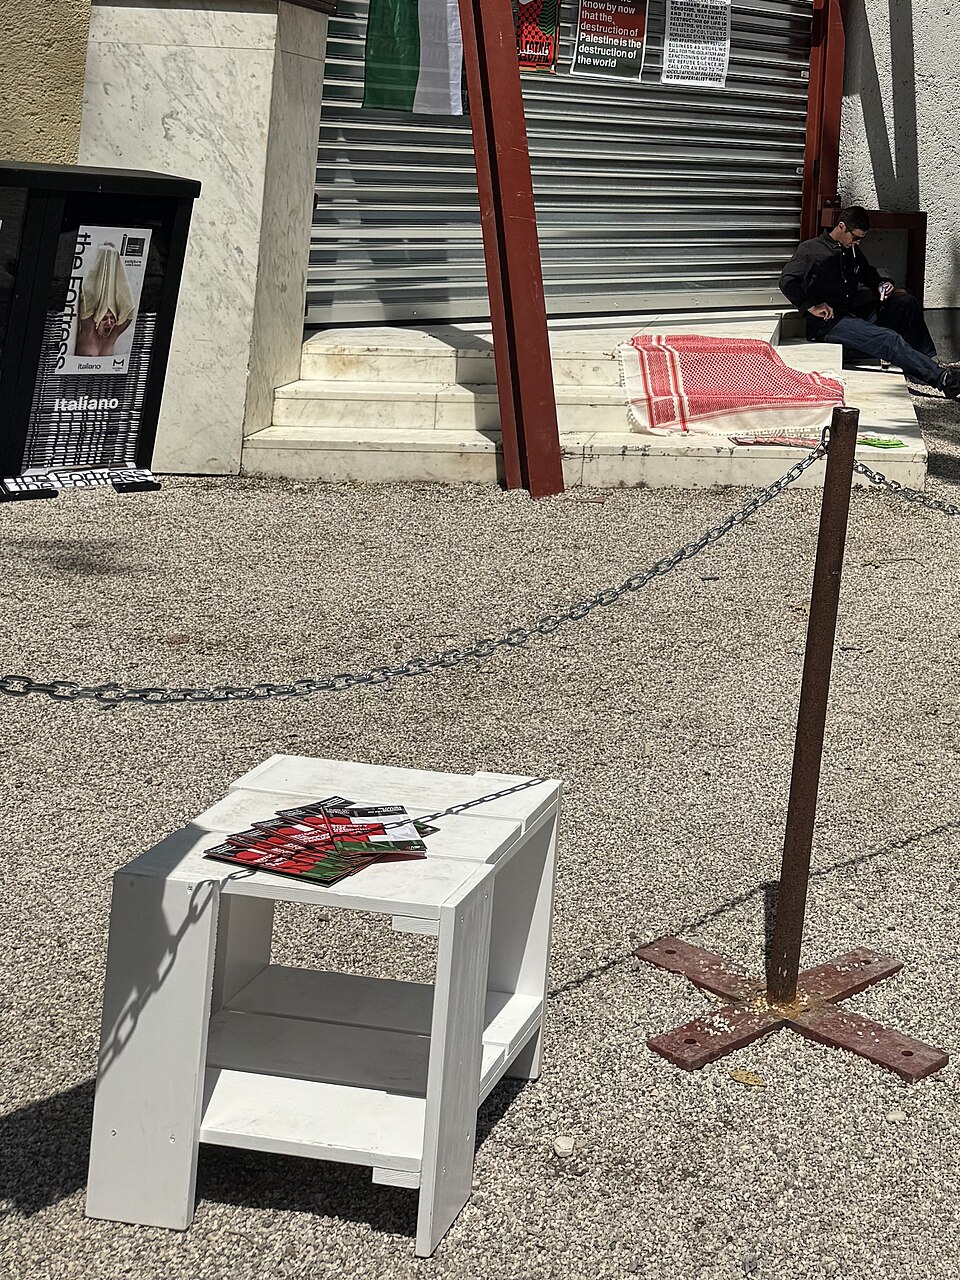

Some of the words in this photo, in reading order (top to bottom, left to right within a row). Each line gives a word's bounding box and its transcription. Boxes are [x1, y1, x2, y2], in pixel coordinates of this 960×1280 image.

[583, 0, 605, 9] know
[607, 2, 616, 13] by
[618, 6, 635, 14] now
[582, 11, 598, 20] that
[600, 13, 612, 22] the
[581, 22, 628, 35] destruction
[580, 32, 619, 45] Palestine
[620, 38, 627, 46] is
[628, 39, 641, 48] the
[579, 44, 626, 57] destruction
[628, 50, 636, 59] of
[578, 55, 591, 64] the
[593, 58, 616, 67] world
[72, 232, 91, 269] the
[54, 277, 83, 369] Fortress
[54, 396, 118, 411] Italiano
